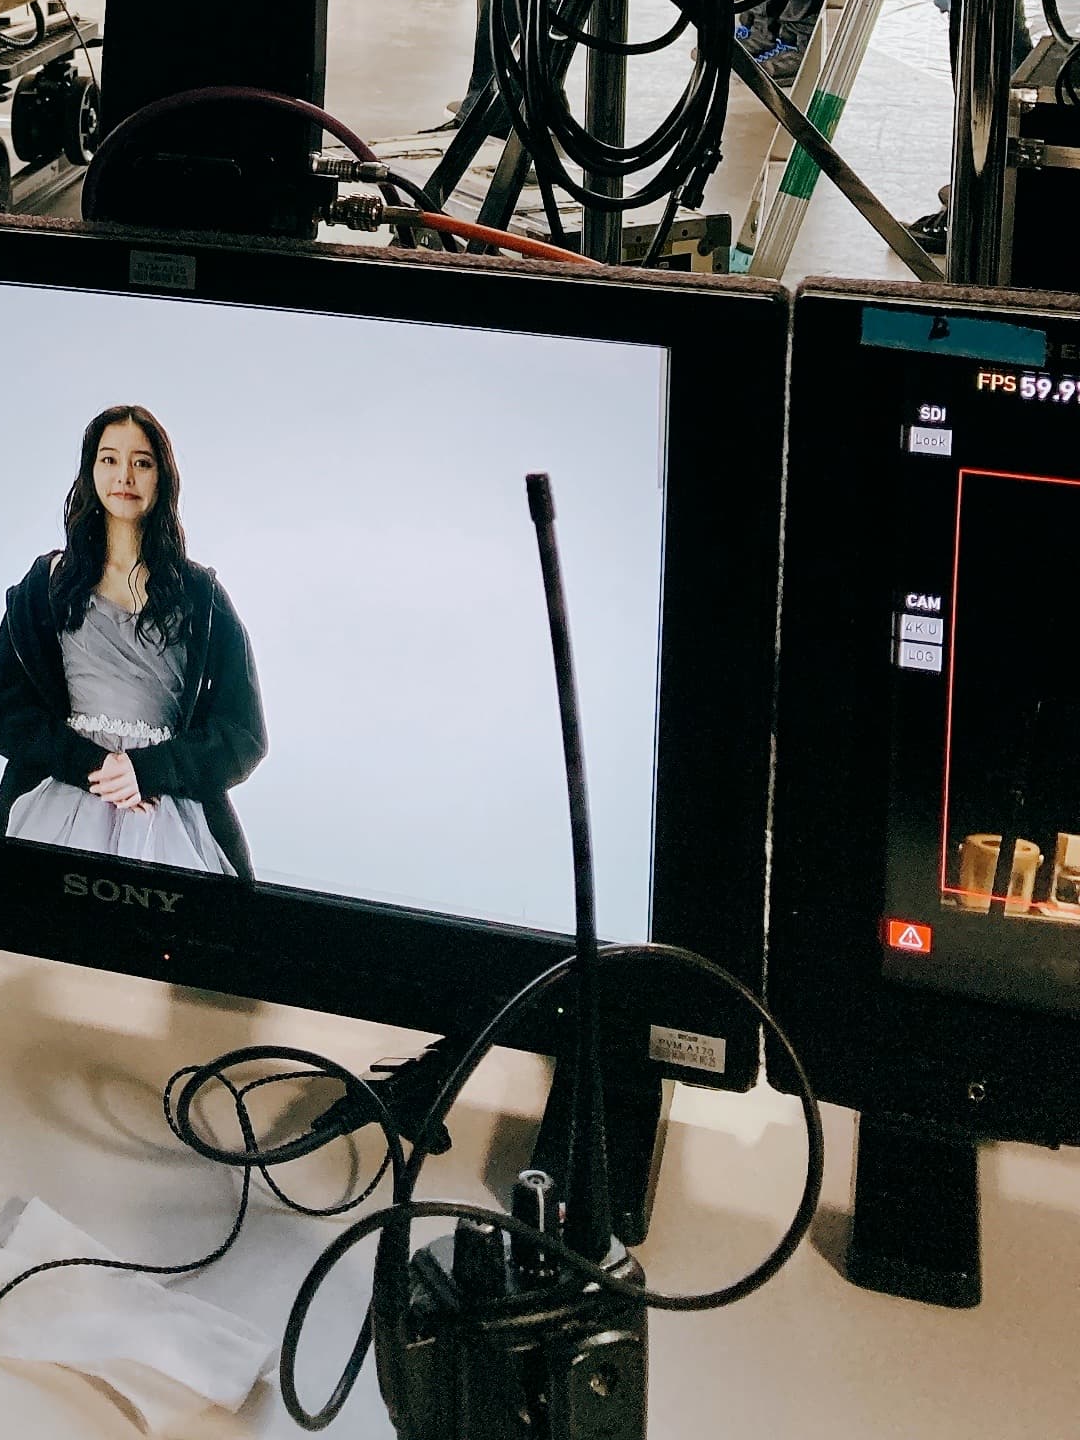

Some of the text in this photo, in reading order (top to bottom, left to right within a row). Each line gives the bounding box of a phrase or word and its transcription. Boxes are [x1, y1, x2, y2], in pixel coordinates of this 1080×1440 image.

[977, 372, 1017, 393] FPS
[919, 405, 947, 423] SDI
[915, 433, 946, 446] Look
[906, 593, 942, 611] CAM
[908, 650, 934, 663] LOG
[62, 871, 184, 913] SONY
